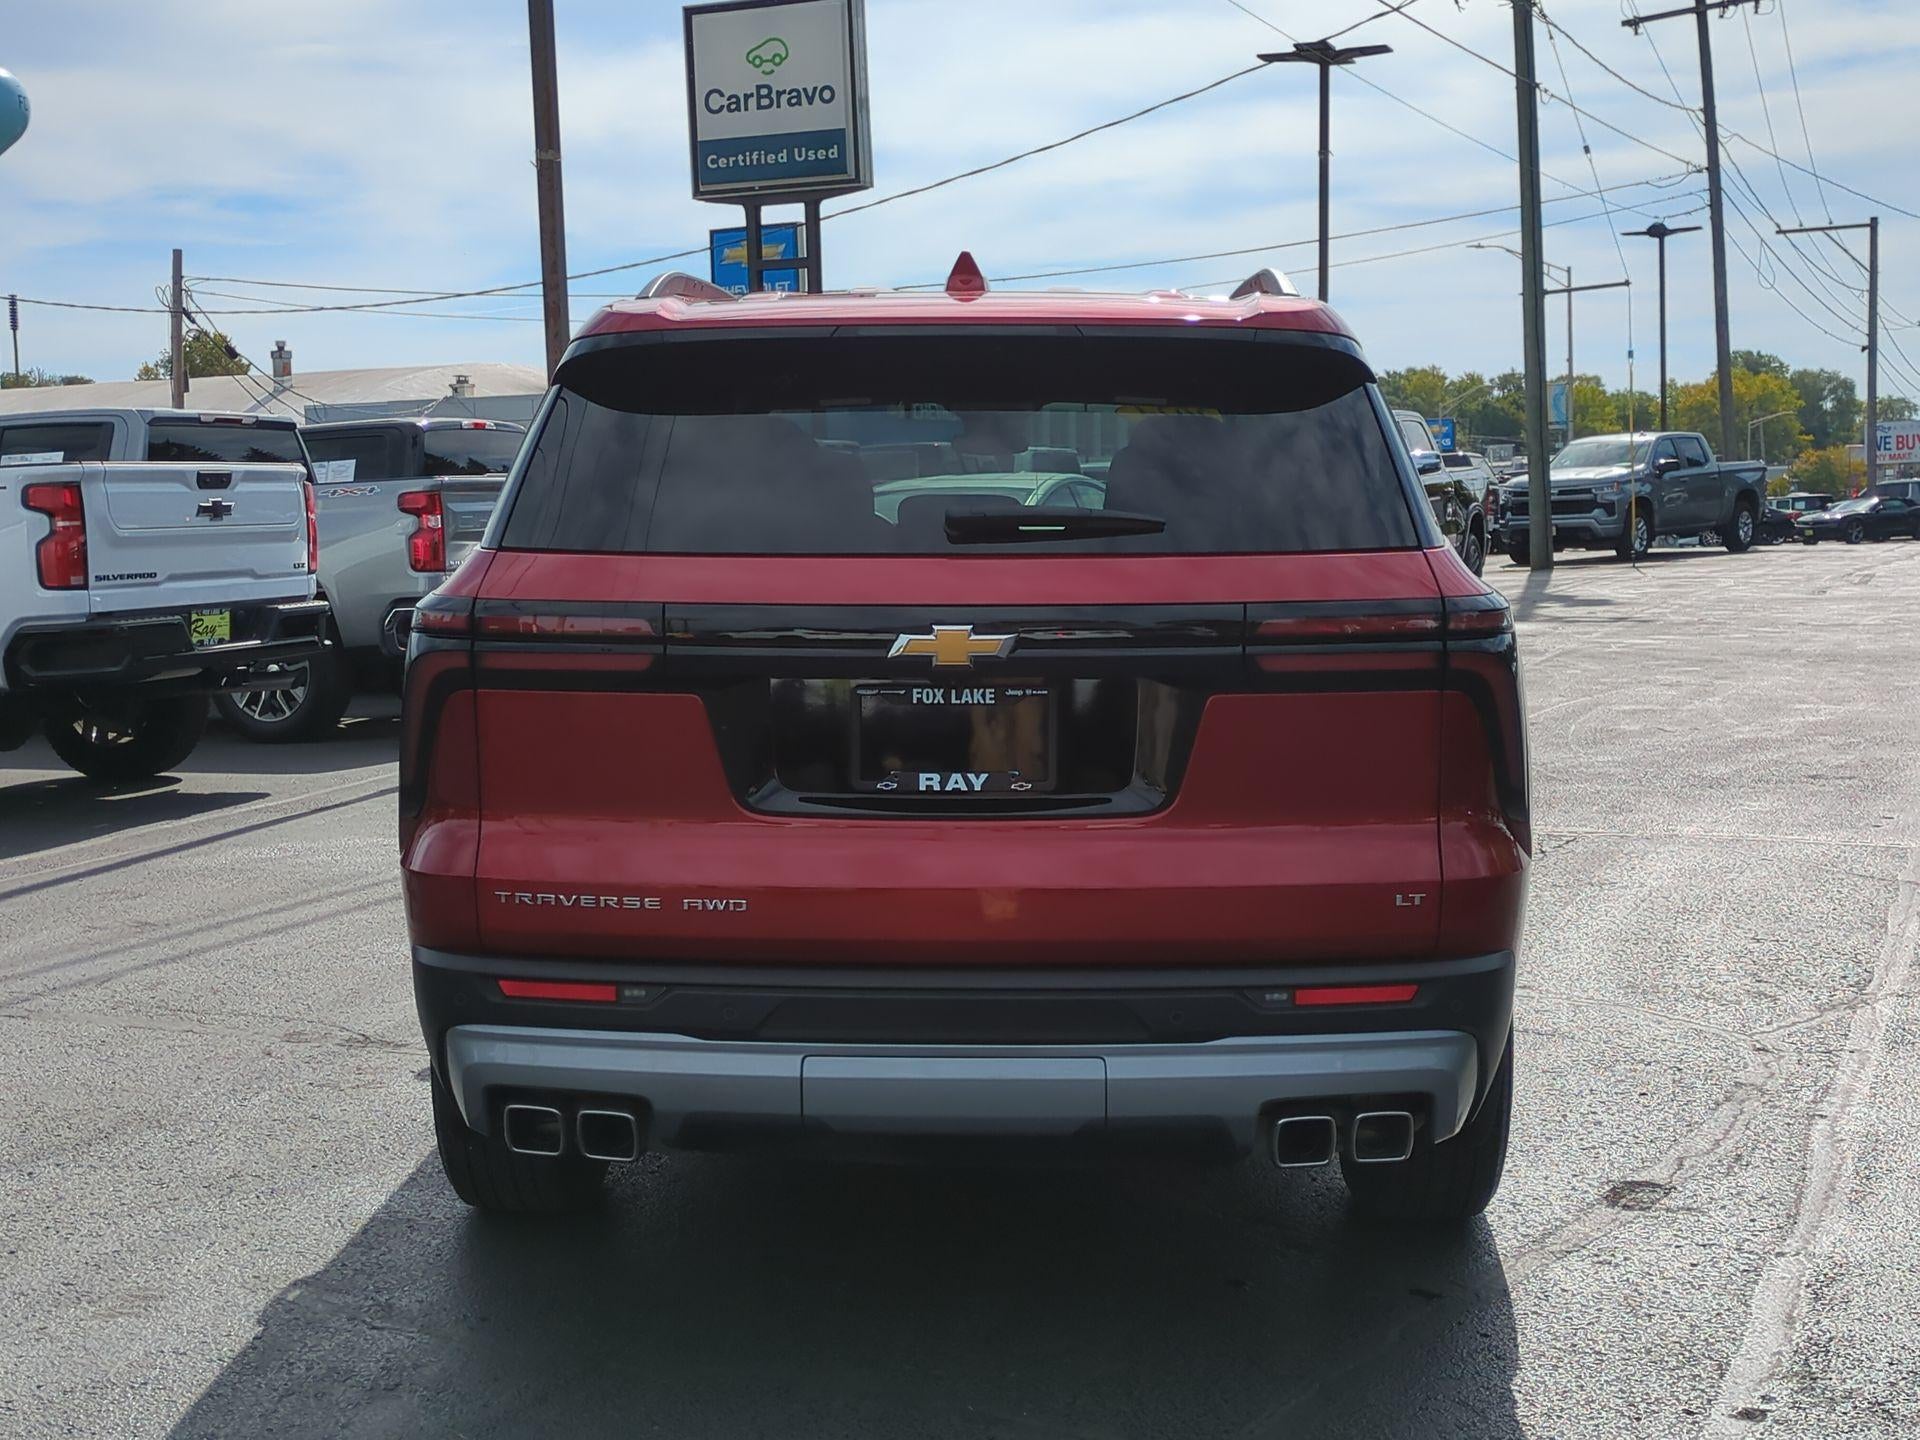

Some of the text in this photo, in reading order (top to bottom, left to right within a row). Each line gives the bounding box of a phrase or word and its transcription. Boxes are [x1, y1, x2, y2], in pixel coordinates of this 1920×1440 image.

[704, 83, 836, 115] CarBravo
[706, 144, 839, 169] Certified Used
[95, 572, 157, 582] SILVERADO
[912, 688, 945, 704] FOX
[951, 688, 996, 704] LAKE
[918, 772, 989, 792] RAY
[494, 891, 748, 911] TRAVERSE AWD
[1396, 893, 1426, 906] LT
